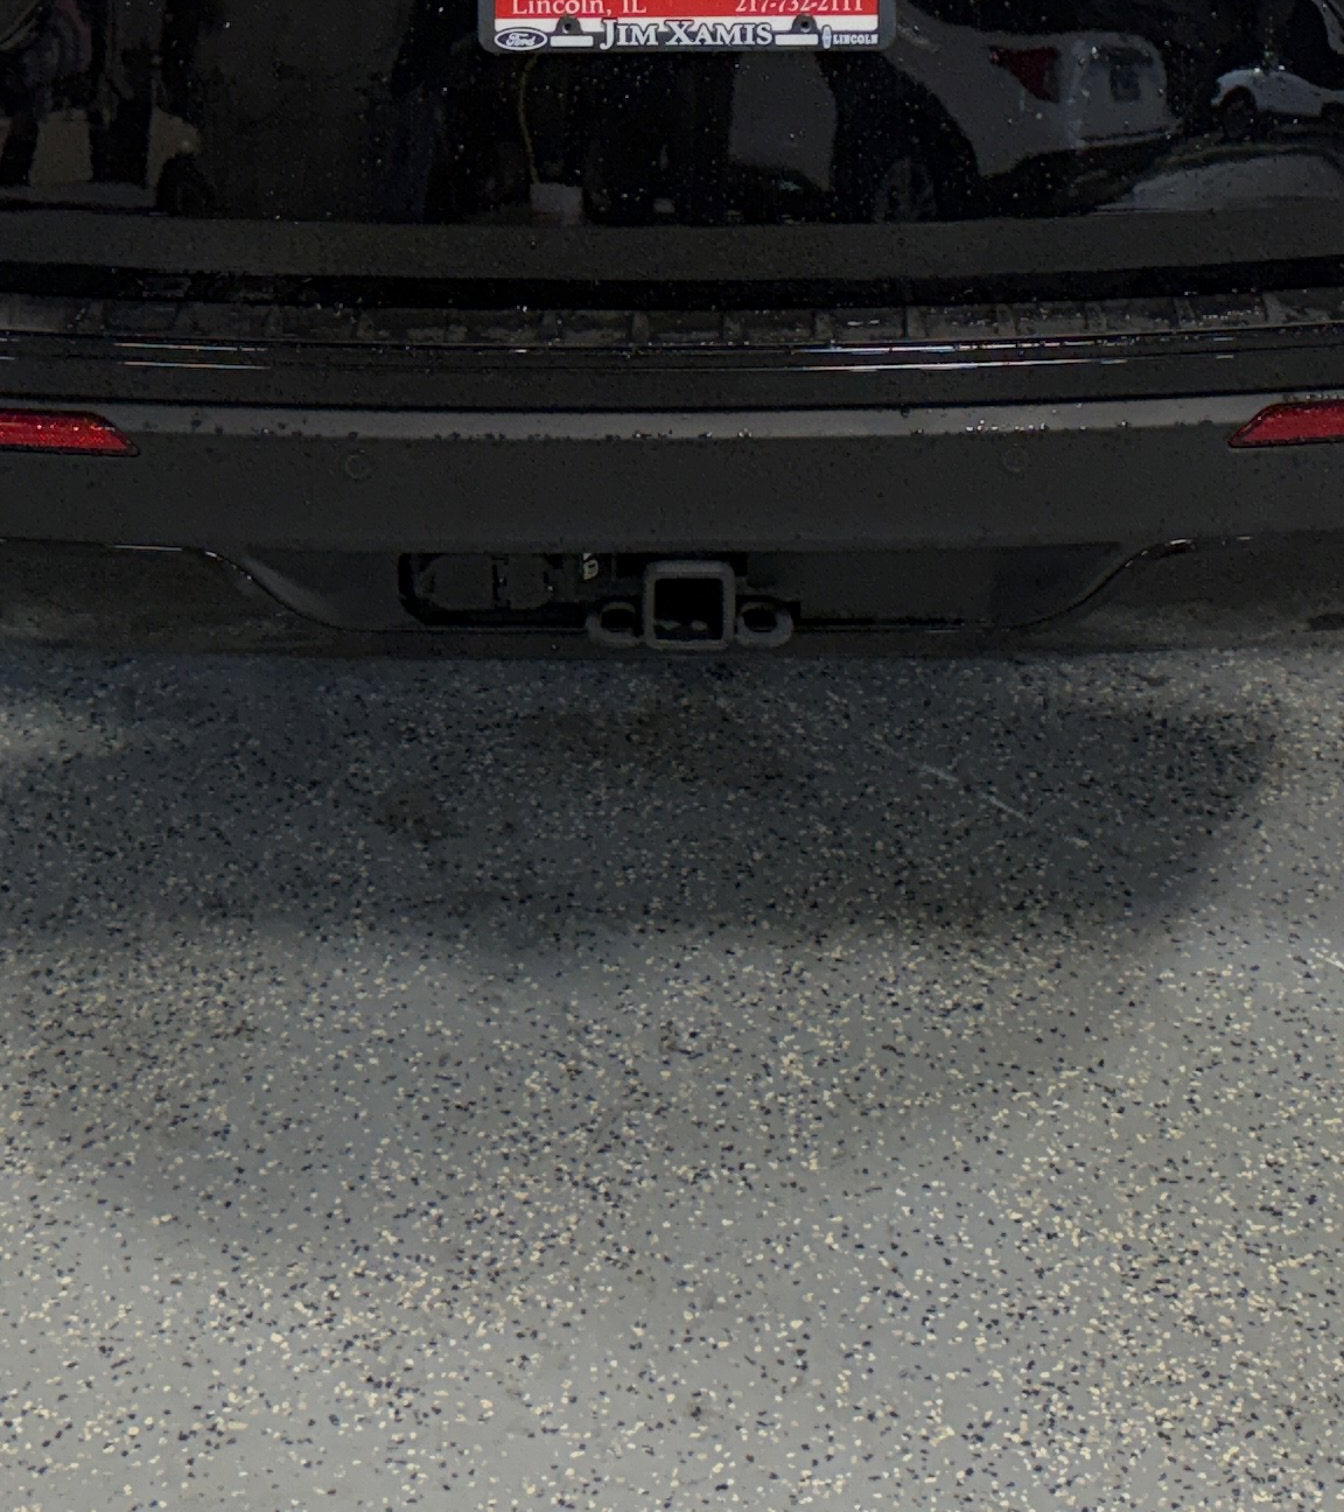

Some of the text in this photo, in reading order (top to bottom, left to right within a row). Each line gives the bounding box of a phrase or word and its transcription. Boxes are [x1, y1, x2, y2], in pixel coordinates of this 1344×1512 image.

[599, 18, 773, 50] JIM XAMIS
[833, 34, 878, 45] LINCOLN
